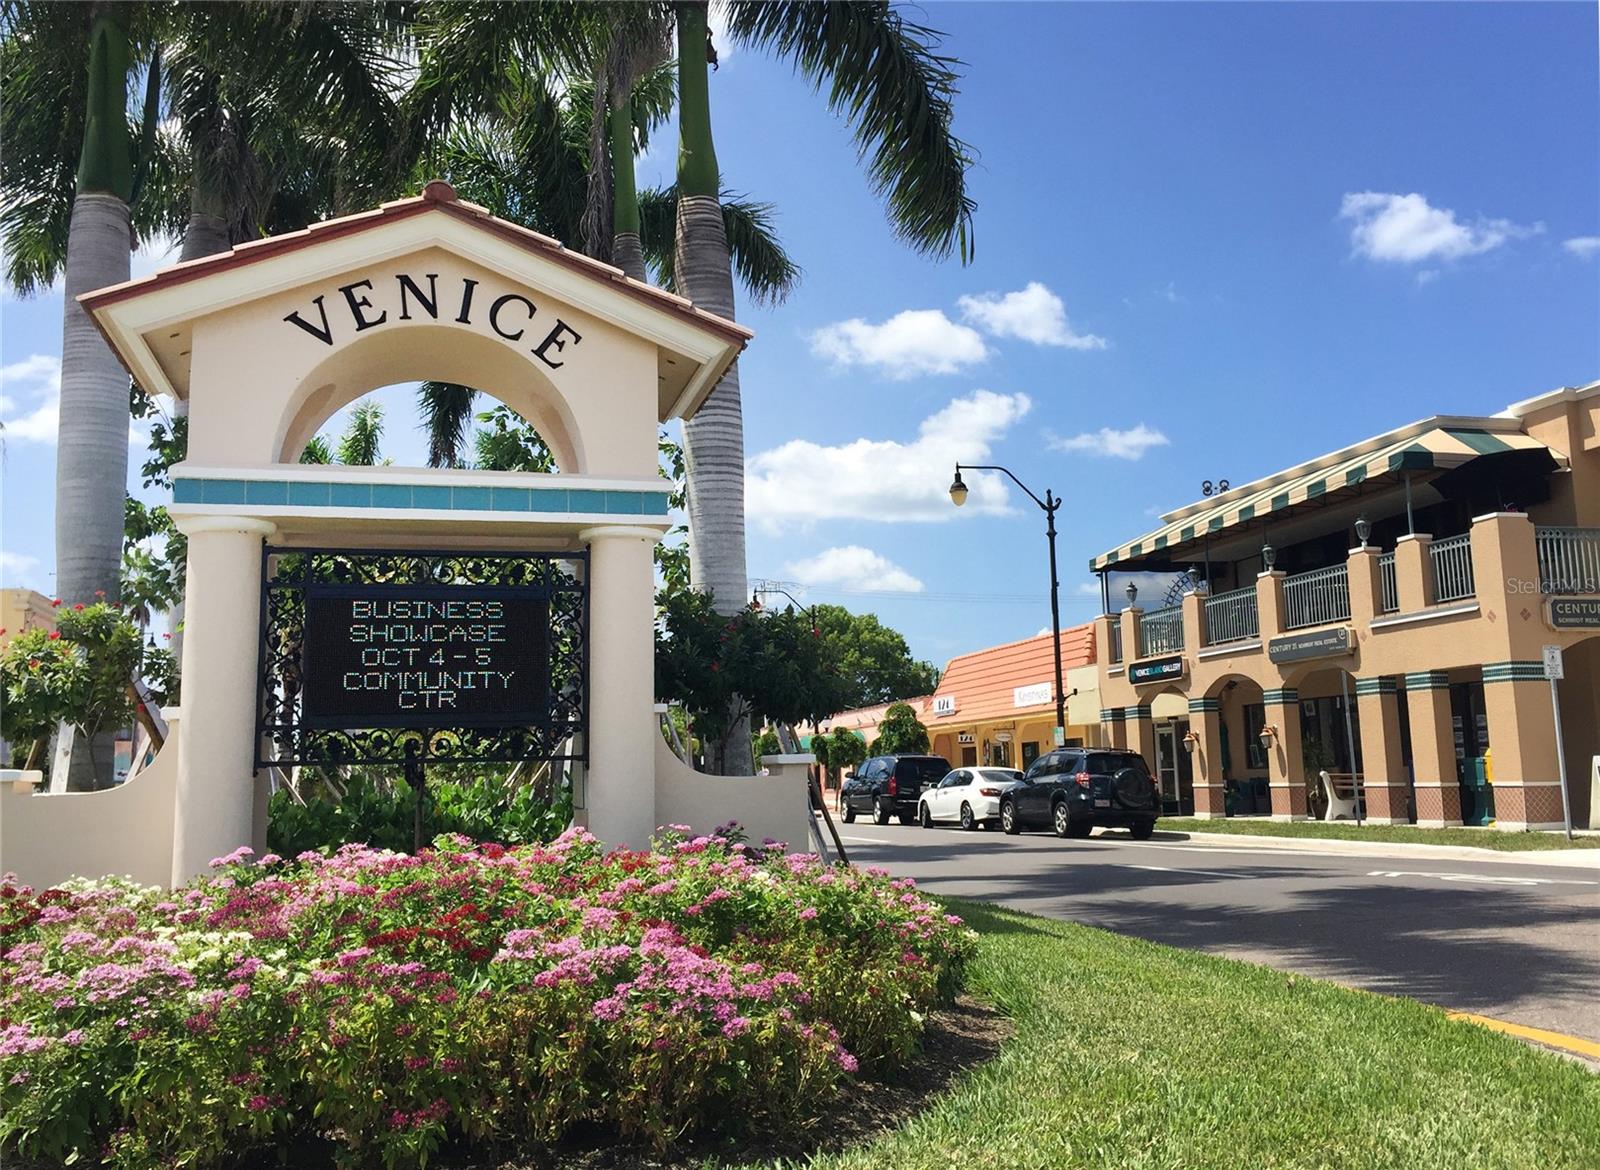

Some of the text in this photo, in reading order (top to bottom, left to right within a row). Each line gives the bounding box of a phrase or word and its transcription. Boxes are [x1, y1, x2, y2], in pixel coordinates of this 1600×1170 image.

[283, 273, 582, 370] VENICE
[352, 601, 504, 618] BUSINESS
[350, 624, 506, 642] SHOWCASE
[362, 647, 421, 666] OCT
[1269, 644, 1291, 654] CENTURY
[343, 671, 515, 690] COMMUNITY
[399, 690, 456, 709] CTR
